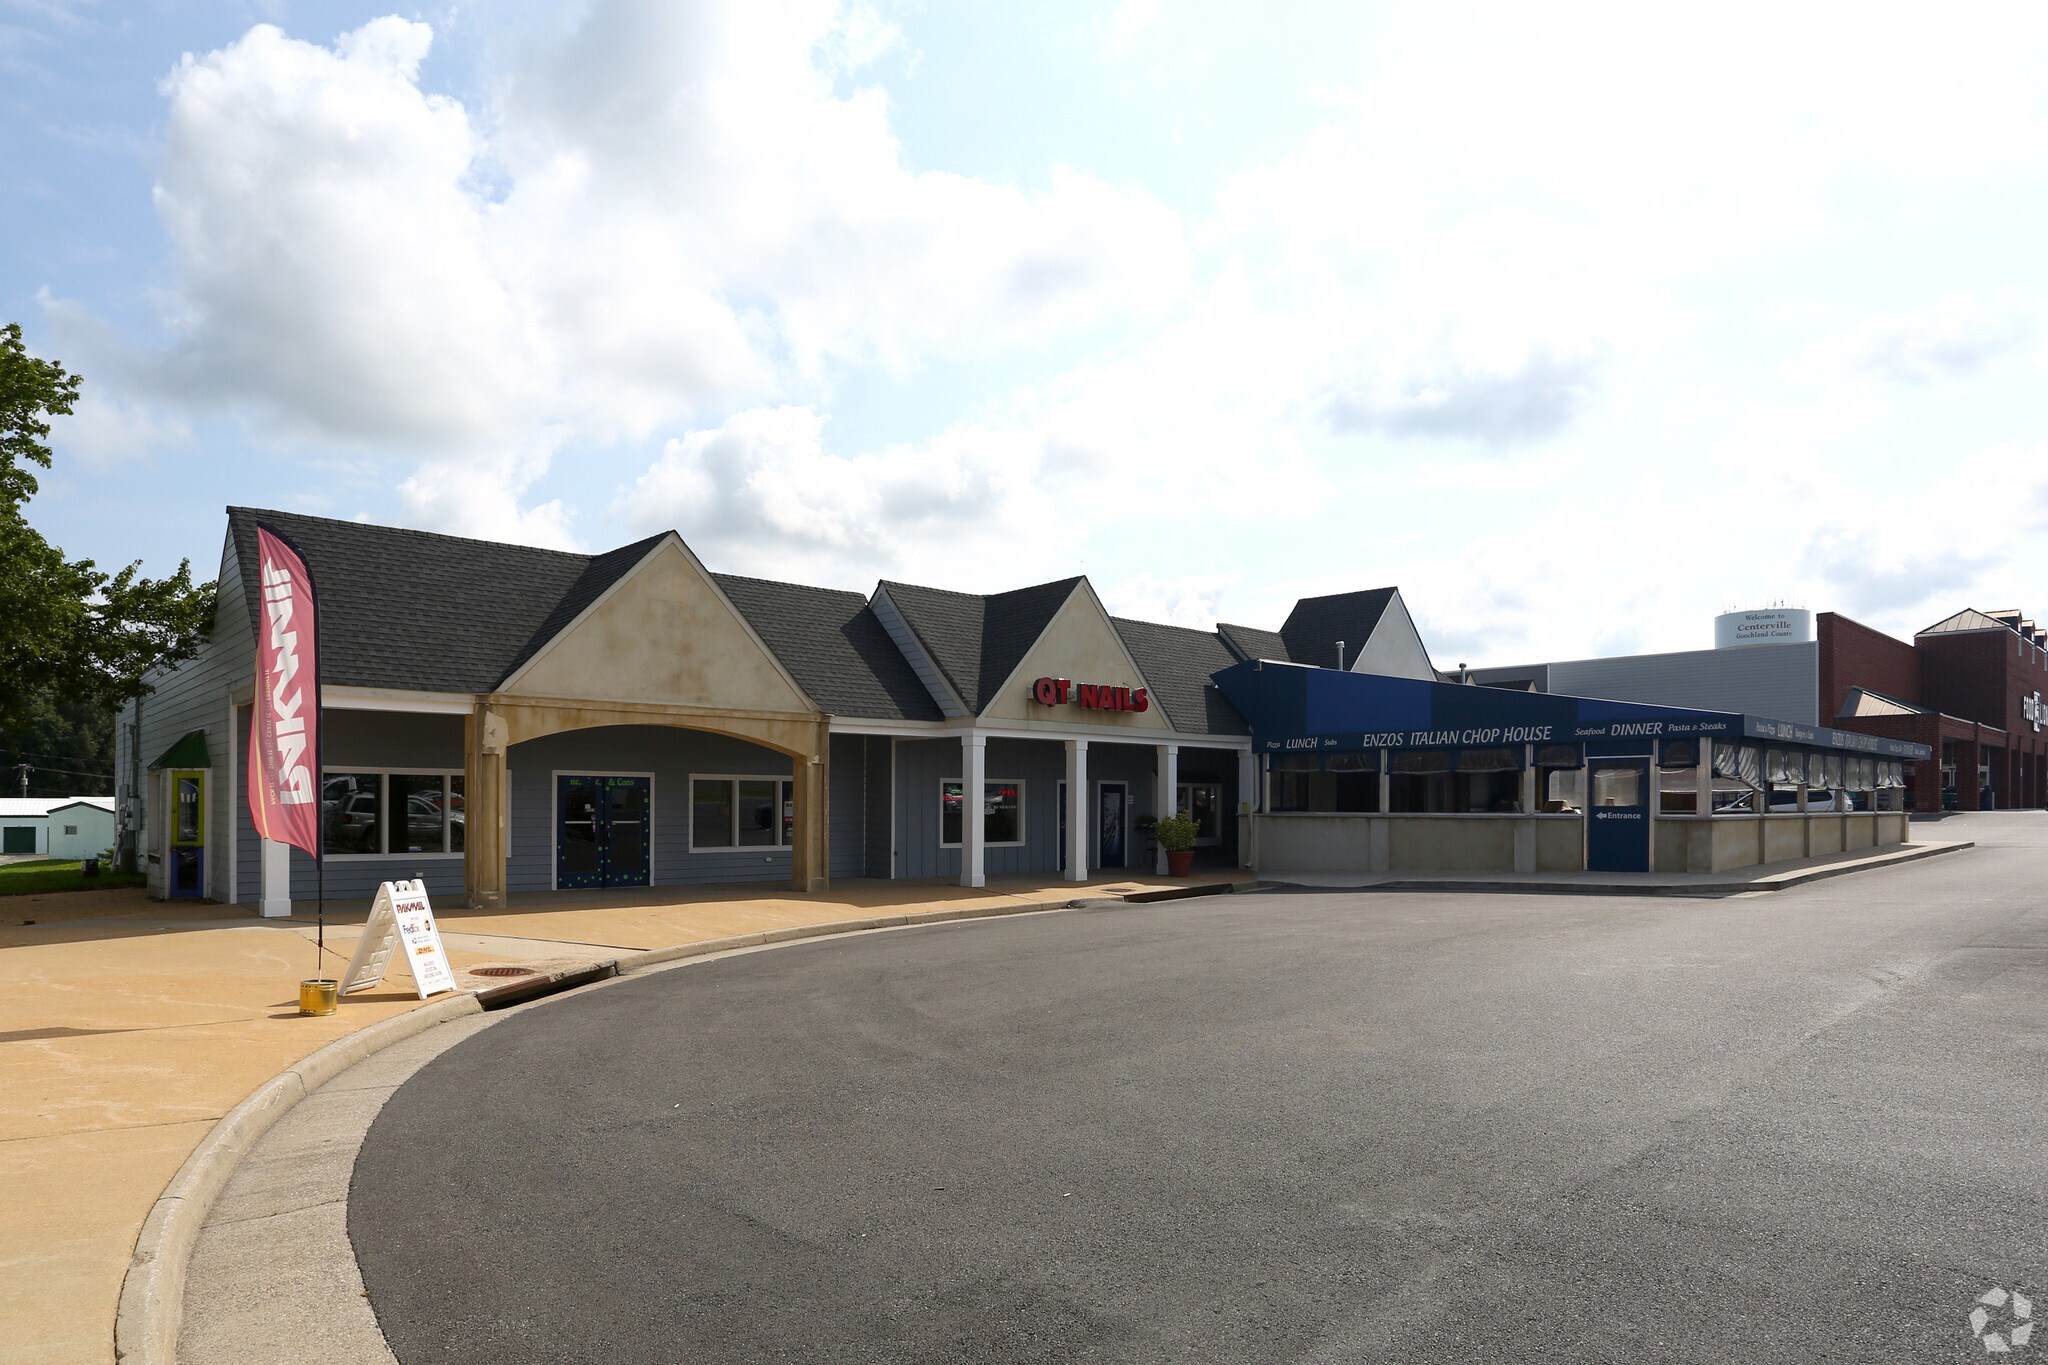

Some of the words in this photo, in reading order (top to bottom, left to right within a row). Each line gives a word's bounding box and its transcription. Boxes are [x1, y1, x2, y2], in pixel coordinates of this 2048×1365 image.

[1738, 621, 1791, 632] Centerville
[1736, 631, 1768, 639] Goochland
[1033, 677, 1071, 707] QT
[1077, 682, 1149, 712] NAILS
[1575, 728, 1605, 736] Seafood
[1610, 722, 1663, 736] DINNER
[1668, 723, 1690, 732] Pasta
[1699, 722, 1727, 731] Steaks
[1363, 732, 1404, 747] ENZOS
[1410, 730, 1459, 746] ITALIAN
[1462, 728, 1500, 744] CHOP
[1502, 726, 1552, 743] HOUSE
[1286, 737, 1318, 749] LUNCH
[1324, 738, 1337, 746] Subs
[402, 923, 420, 934] FedEx
